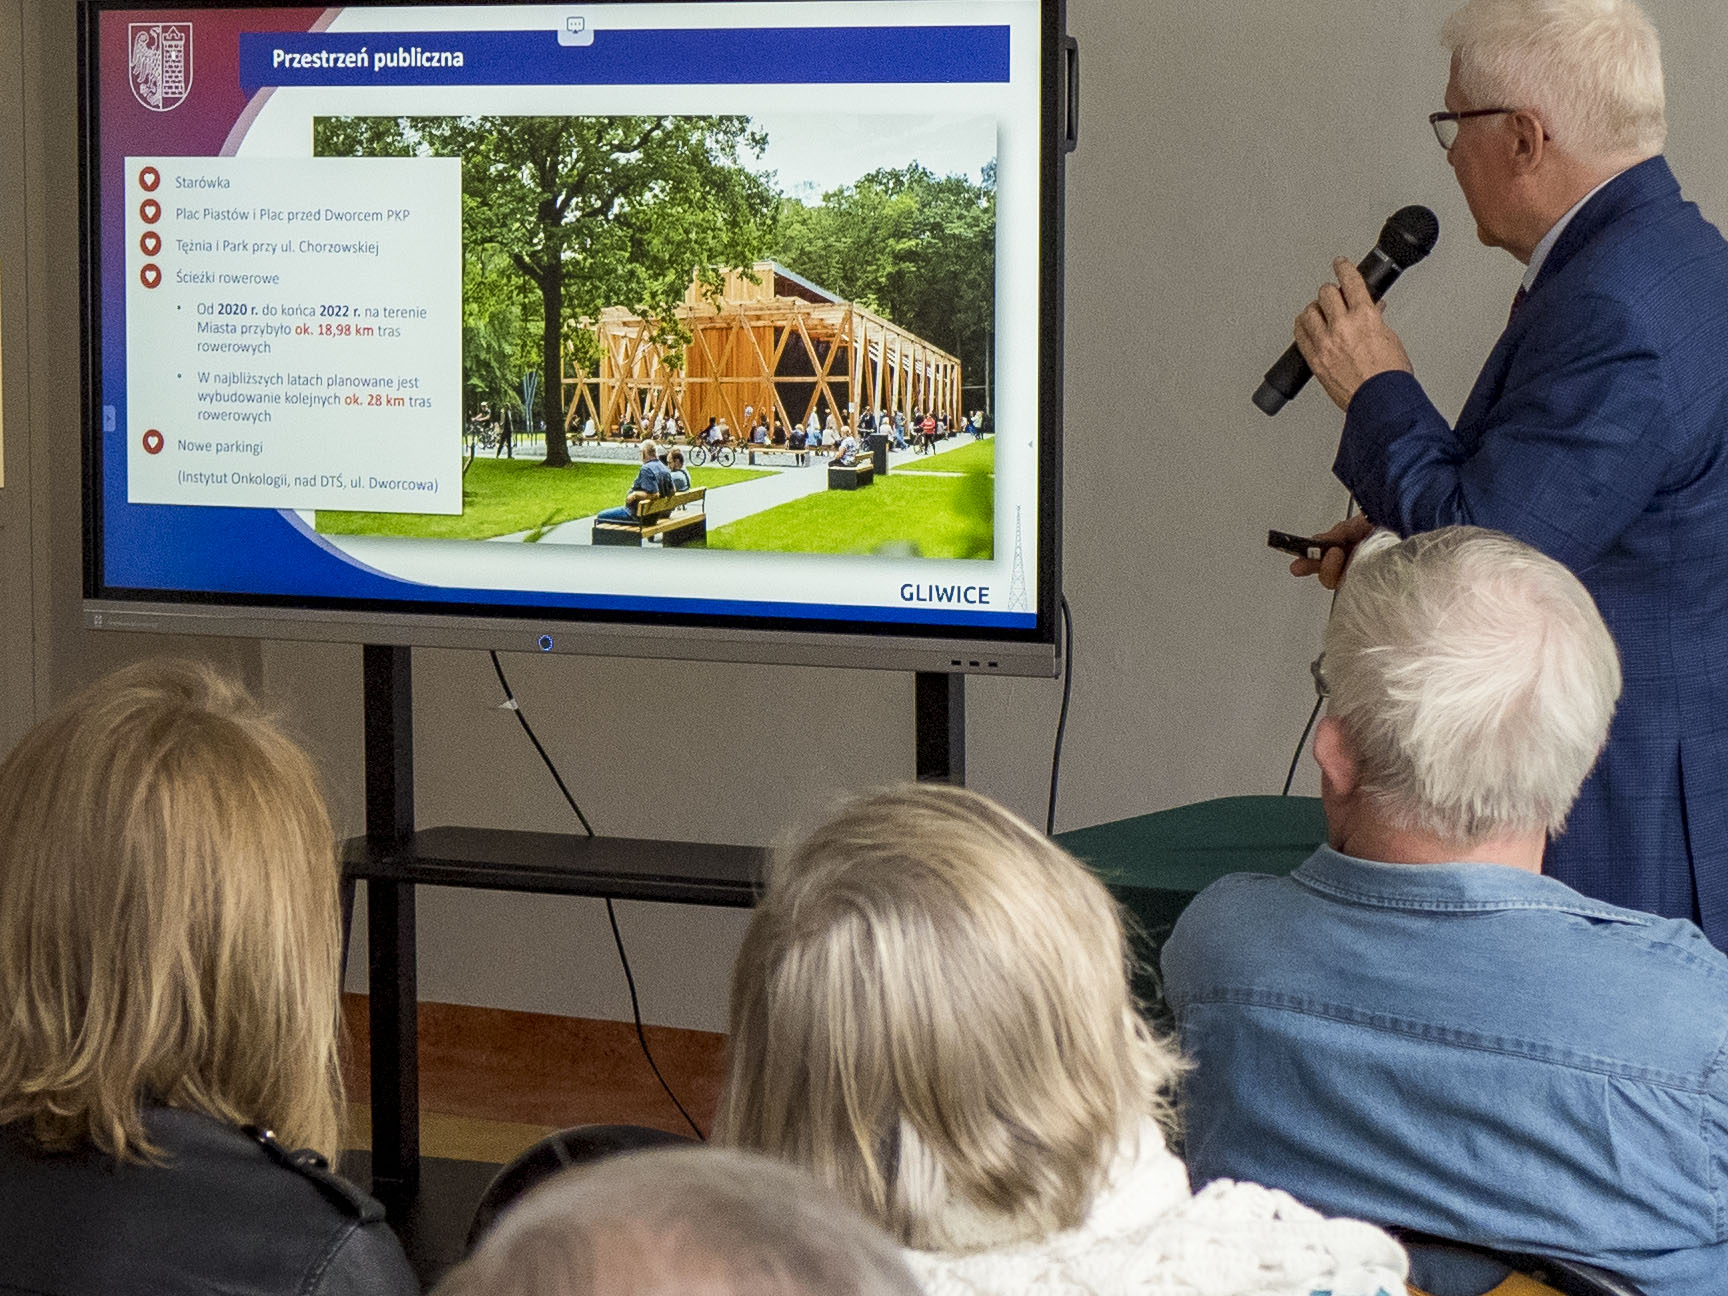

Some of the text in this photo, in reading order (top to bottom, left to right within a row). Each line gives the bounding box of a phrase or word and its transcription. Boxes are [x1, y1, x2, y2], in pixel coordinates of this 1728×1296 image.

[272, 47, 464, 72] Przestrzeń publiczna
[175, 176, 230, 190] Starówka
[176, 207, 411, 224] Plac Piastów i Plac przed Dworcem PKP
[176, 239, 213, 255] Tężnia
[222, 240, 249, 253] Park
[252, 243, 278, 256] przy
[281, 240, 295, 253] ul.
[298, 240, 380, 256] Chorzowskiej
[218, 273, 280, 285] rowerowe
[197, 303, 427, 319] Od 2020 r. do końca 2022 r. na terenie
[197, 322, 401, 339] Miasta przybyło ok. 18,98 km tras
[197, 339, 271, 356] rowerowych
[197, 372, 420, 391] W najbliższych latach planowane jest
[197, 390, 432, 409] wybudowanie kolejnych ok. 28 km tras
[197, 408, 272, 425] rowerowych
[177, 440, 263, 456] Nowe parkingi
[177, 470, 228, 487] (Instytut
[231, 472, 291, 489] Onkologii,
[294, 474, 316, 487] nad
[350, 476, 365, 489] ul.
[368, 476, 439, 494] Dworcowa)
[900, 584, 990, 605] GLIWICE
